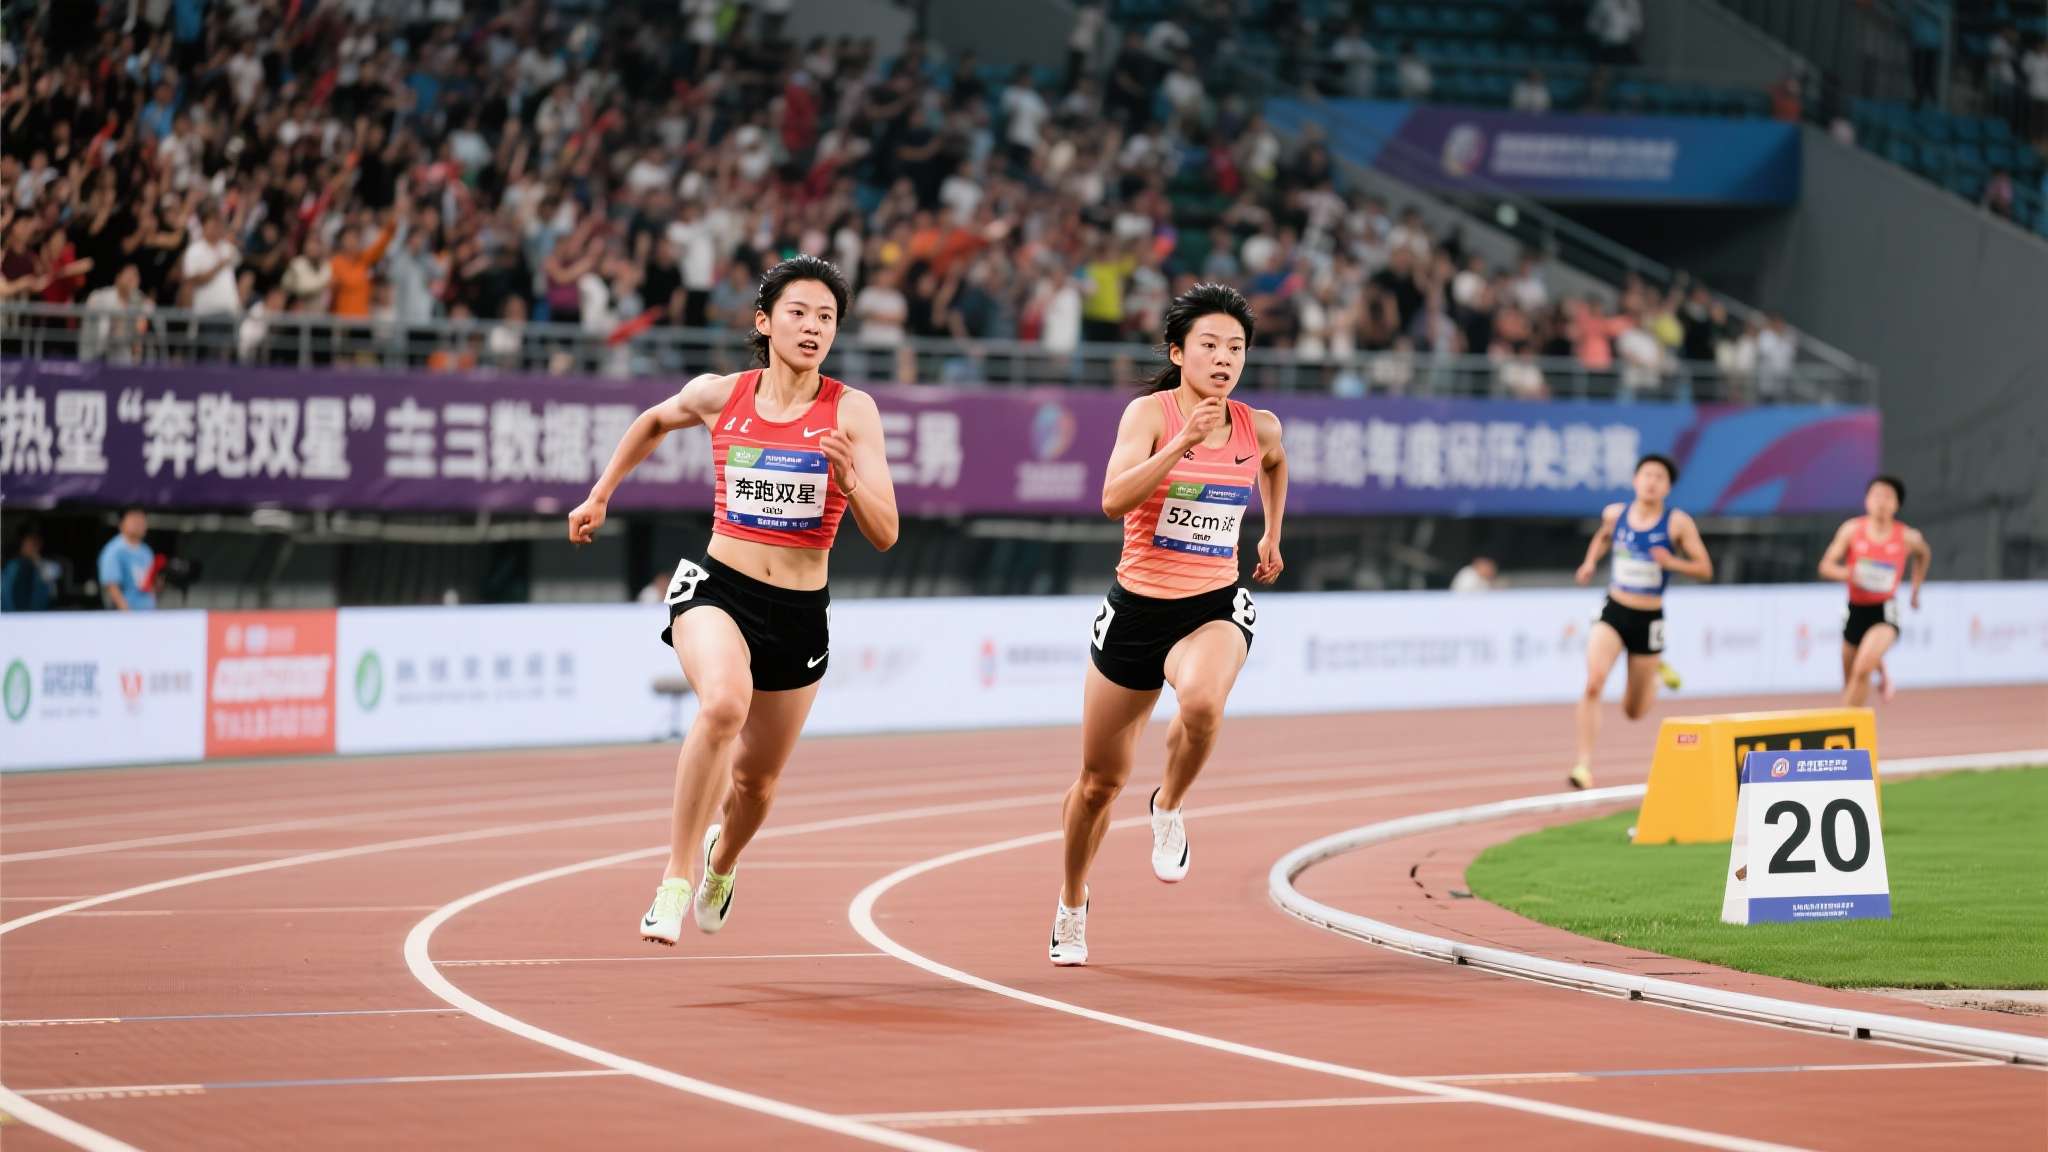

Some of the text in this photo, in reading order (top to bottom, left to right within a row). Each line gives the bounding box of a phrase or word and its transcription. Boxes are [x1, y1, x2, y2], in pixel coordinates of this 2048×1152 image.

[735, 477, 816, 505] 奔跑双星
[1764, 798, 1871, 874] 20
